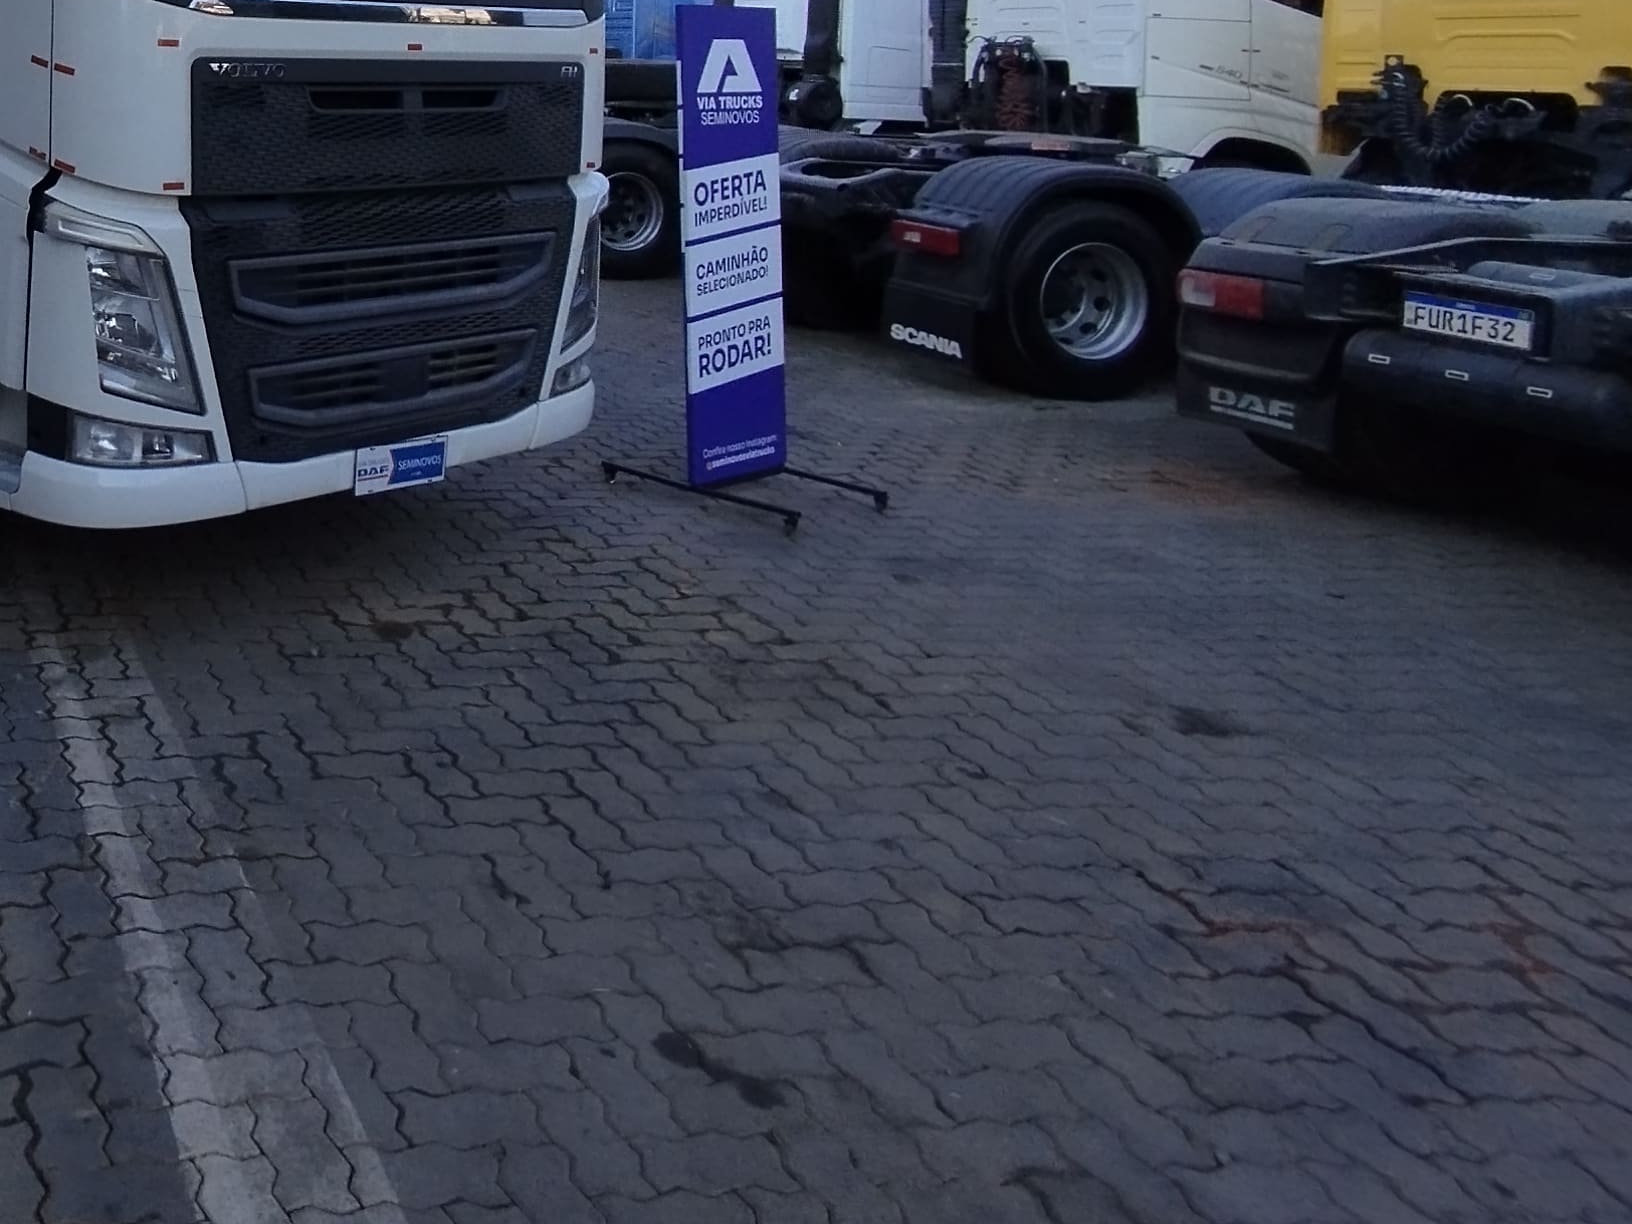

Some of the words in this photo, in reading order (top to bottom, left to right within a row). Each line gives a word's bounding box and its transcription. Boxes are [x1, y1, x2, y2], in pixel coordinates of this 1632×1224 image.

[208, 62, 286, 77] VOLVO
[697, 96, 716, 110] VIA
[718, 95, 763, 109] TRUCKS
[701, 110, 760, 125] SEMINOVOS
[694, 169, 767, 206] OFERTA
[695, 196, 767, 227] IMPERDÍVEL!
[696, 245, 768, 280] CAMINHÃO
[698, 323, 746, 351] PRONTO
[748, 316, 771, 334] PRA
[890, 323, 963, 359] SCANIA
[1414, 306, 1515, 343] FUR1F32
[699, 332, 771, 378] RODAR!
[1209, 386, 1295, 417] DAF
[358, 465, 389, 477] DAF
